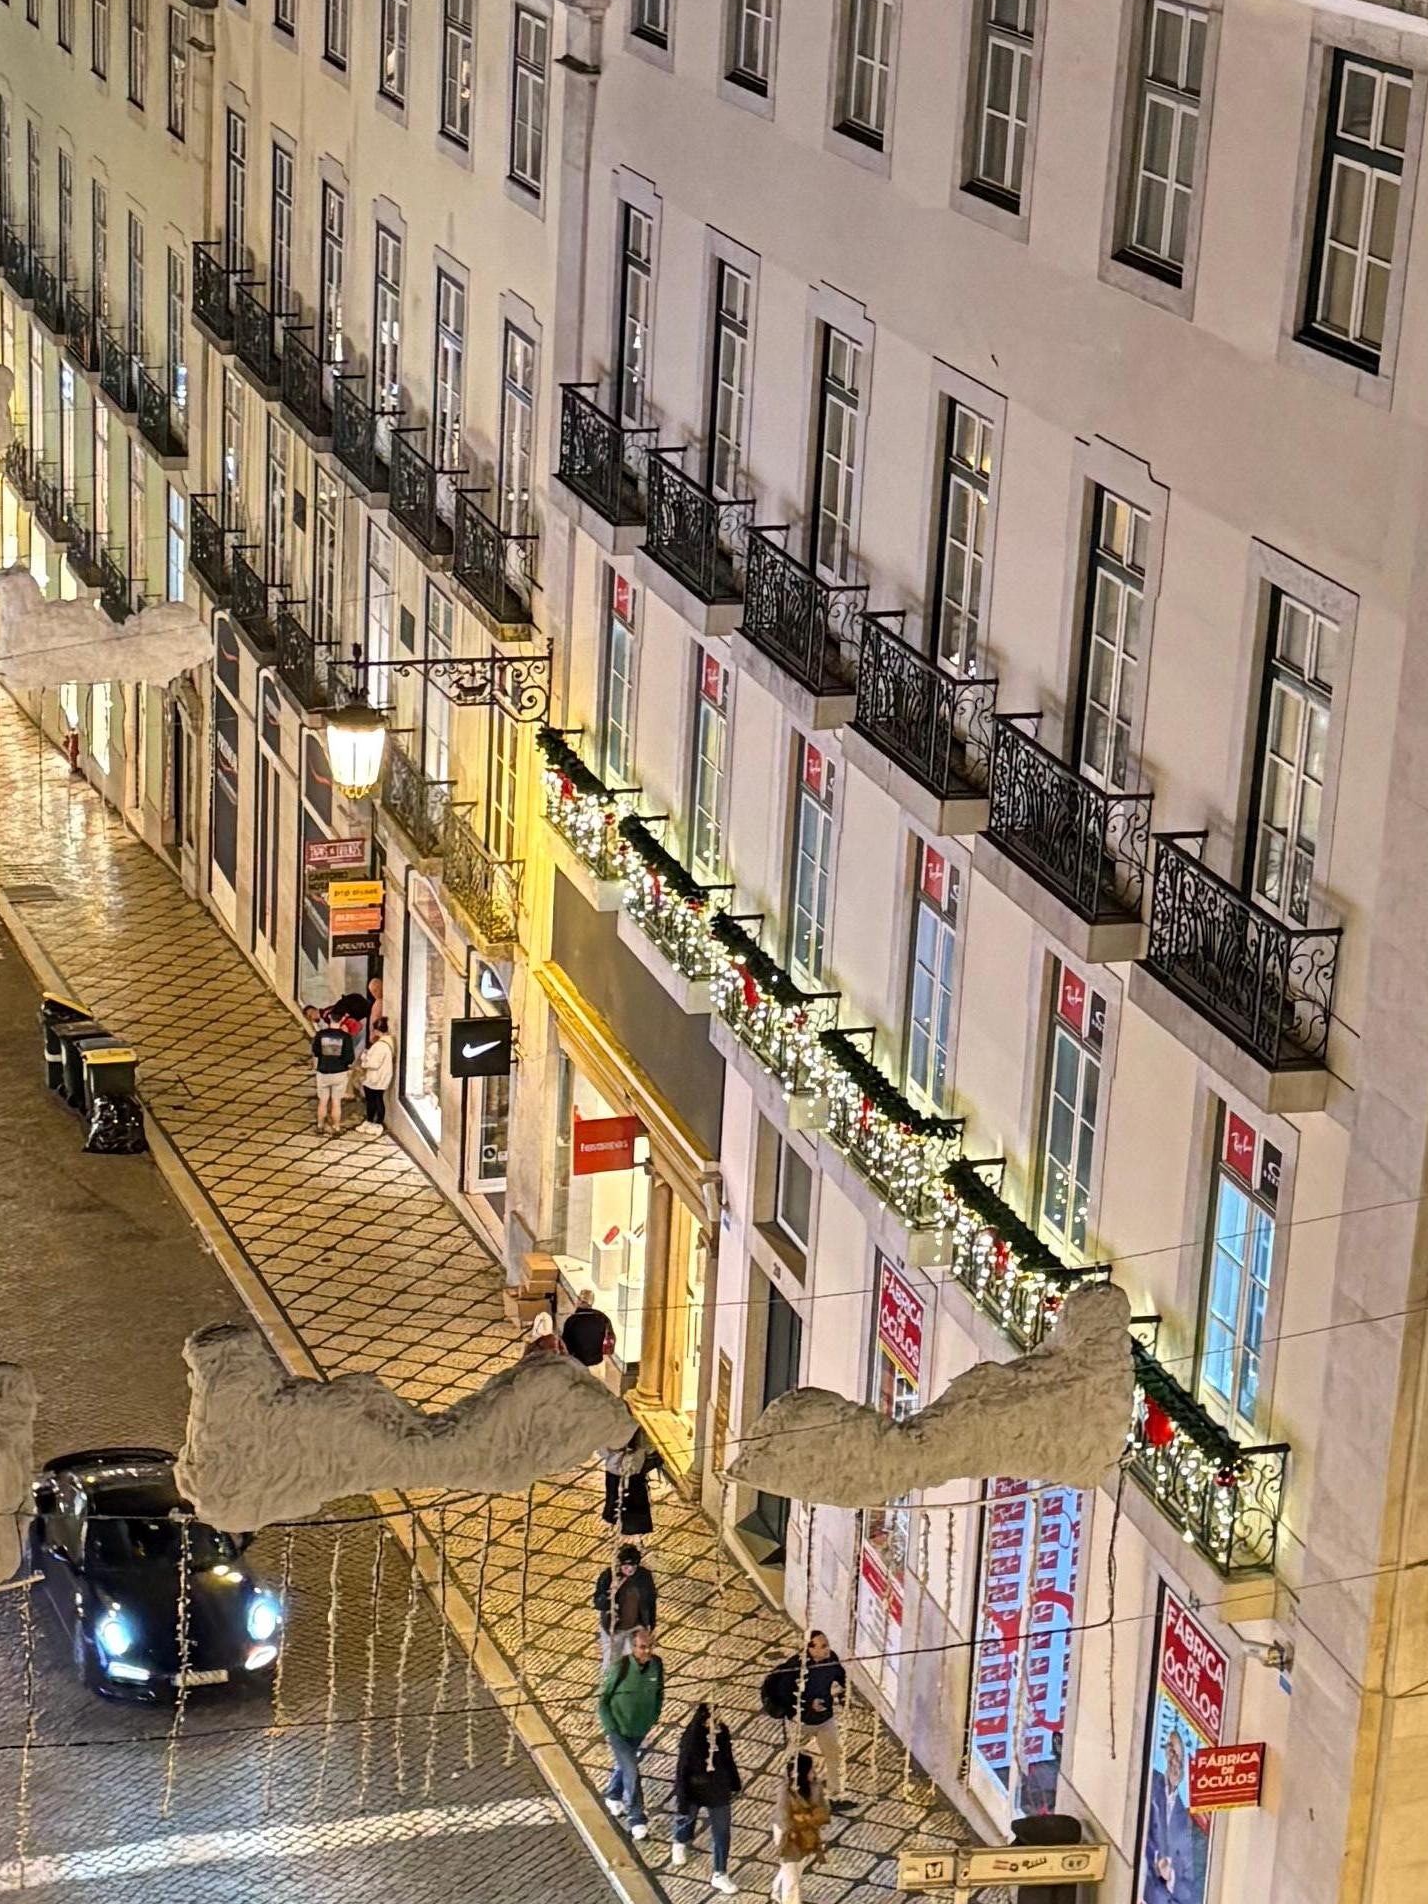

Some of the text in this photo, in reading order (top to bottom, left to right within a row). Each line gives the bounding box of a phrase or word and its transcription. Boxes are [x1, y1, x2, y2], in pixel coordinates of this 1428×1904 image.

[882, 1269, 922, 1334] FÁBRICA
[881, 1303, 920, 1368] ÓCULOS
[1166, 1604, 1225, 1691] FÁBRICA
[1187, 1654, 1201, 1682] DE
[1164, 1646, 1221, 1731] ÓCULOS
[1197, 1750, 1260, 1769] FÁBRICA
[1197, 1771, 1257, 1789] ÓCULOS
[1220, 1763, 1235, 1775] DE
